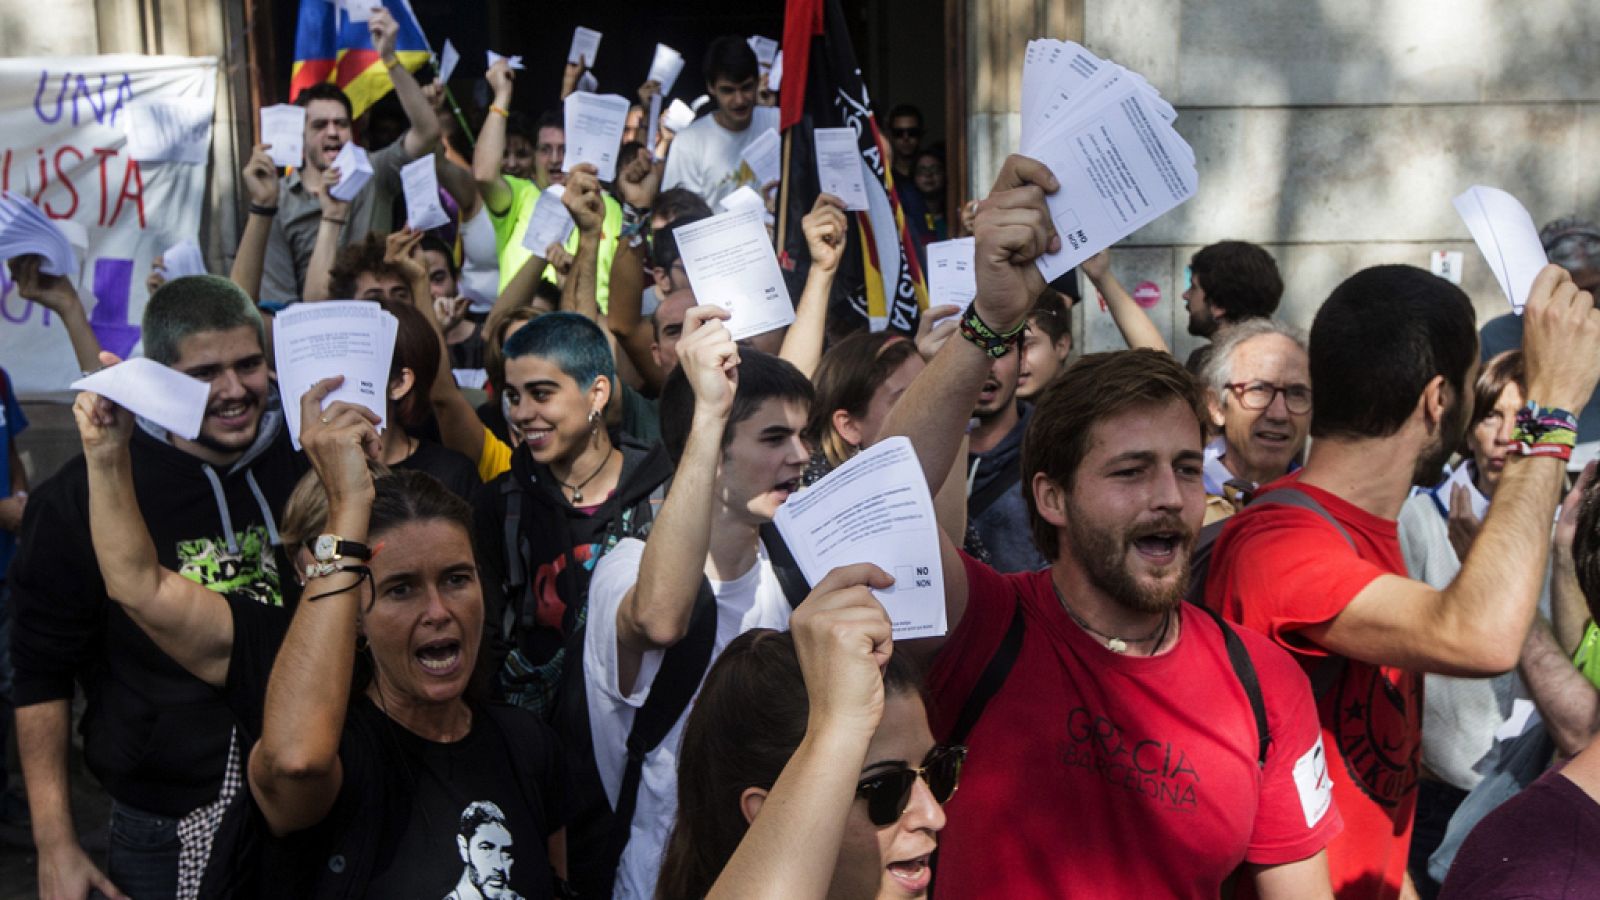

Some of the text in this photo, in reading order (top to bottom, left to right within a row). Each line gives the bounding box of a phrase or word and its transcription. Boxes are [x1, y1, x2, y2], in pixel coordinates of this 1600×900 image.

[34, 69, 133, 128] UNA
[916, 566, 929, 576] NO
[916, 579, 931, 587] NON
